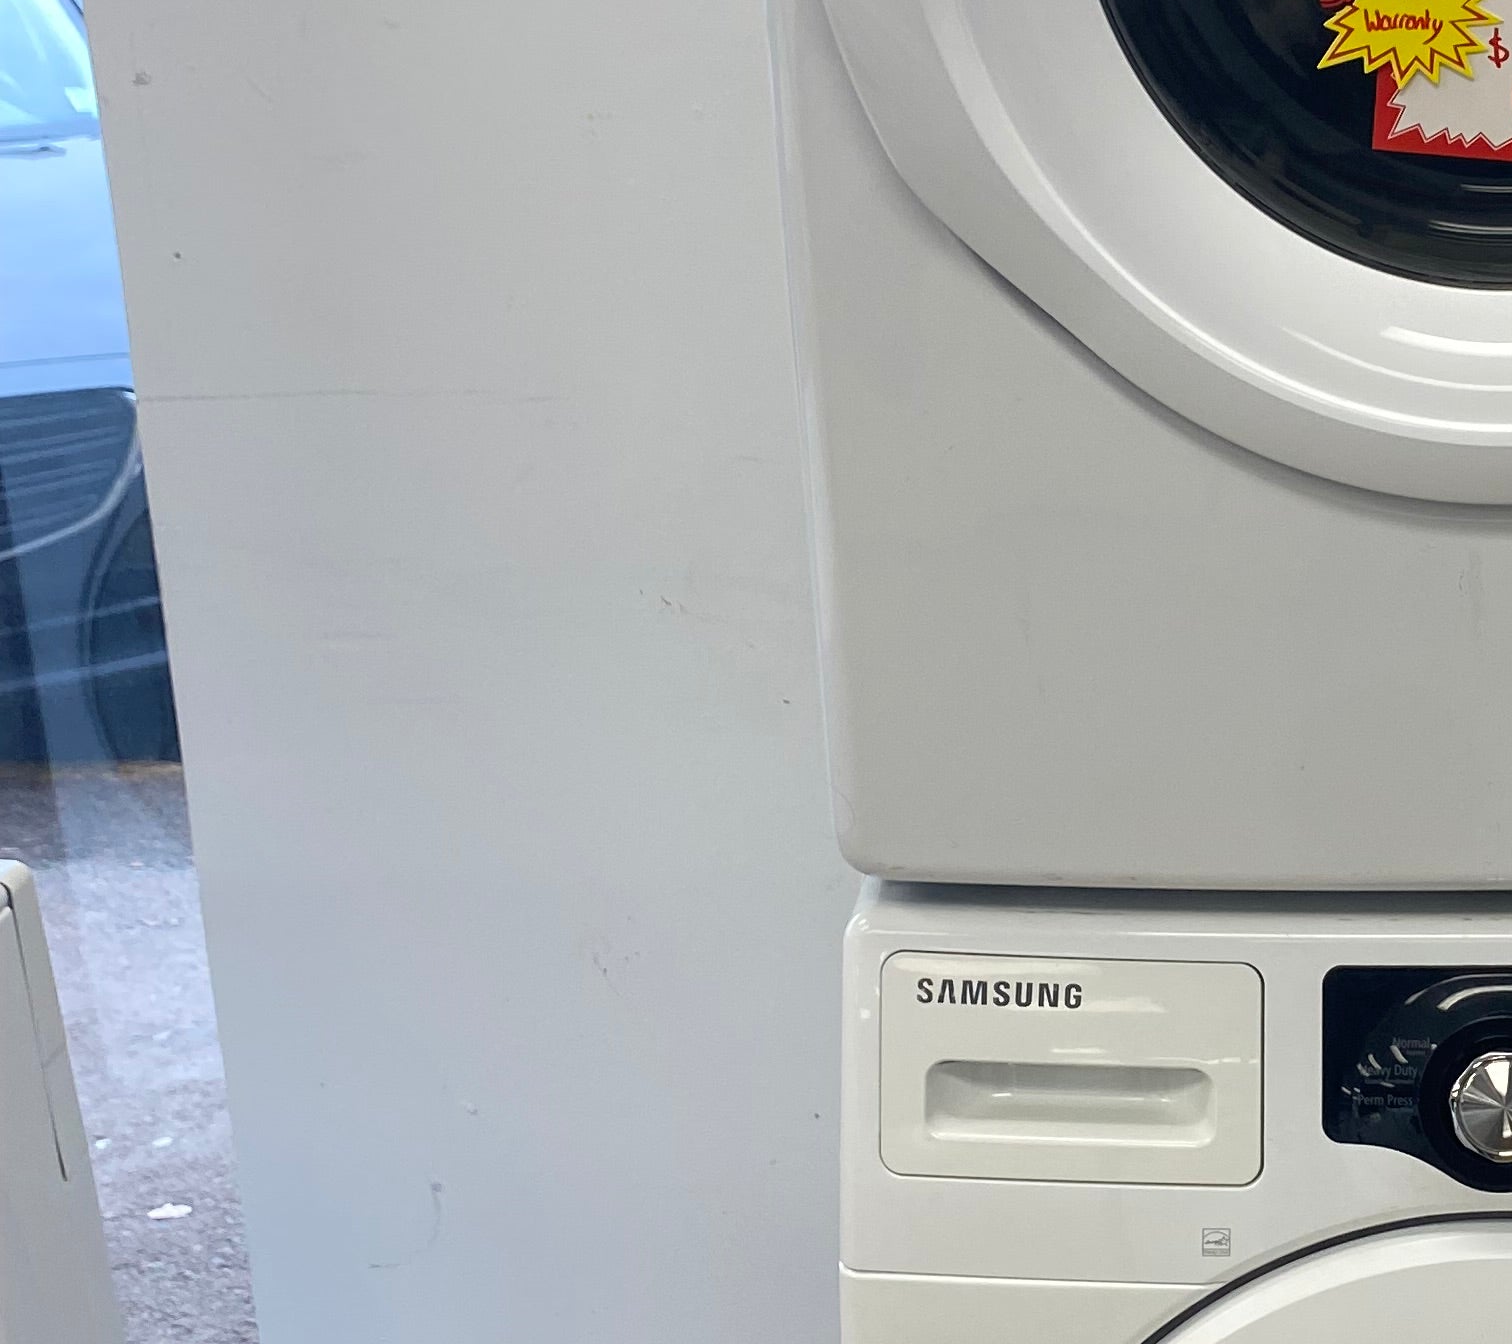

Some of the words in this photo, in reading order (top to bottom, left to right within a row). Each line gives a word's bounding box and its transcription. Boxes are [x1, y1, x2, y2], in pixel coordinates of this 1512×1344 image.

[1364, 9, 1444, 45] Warranty
[915, 976, 1083, 1011] SAMSUNG
[1391, 1037, 1431, 1049] Normal
[1394, 1064, 1418, 1078] Duty
[1357, 1094, 1384, 1105] Perm
[1387, 1094, 1414, 1106] Press
